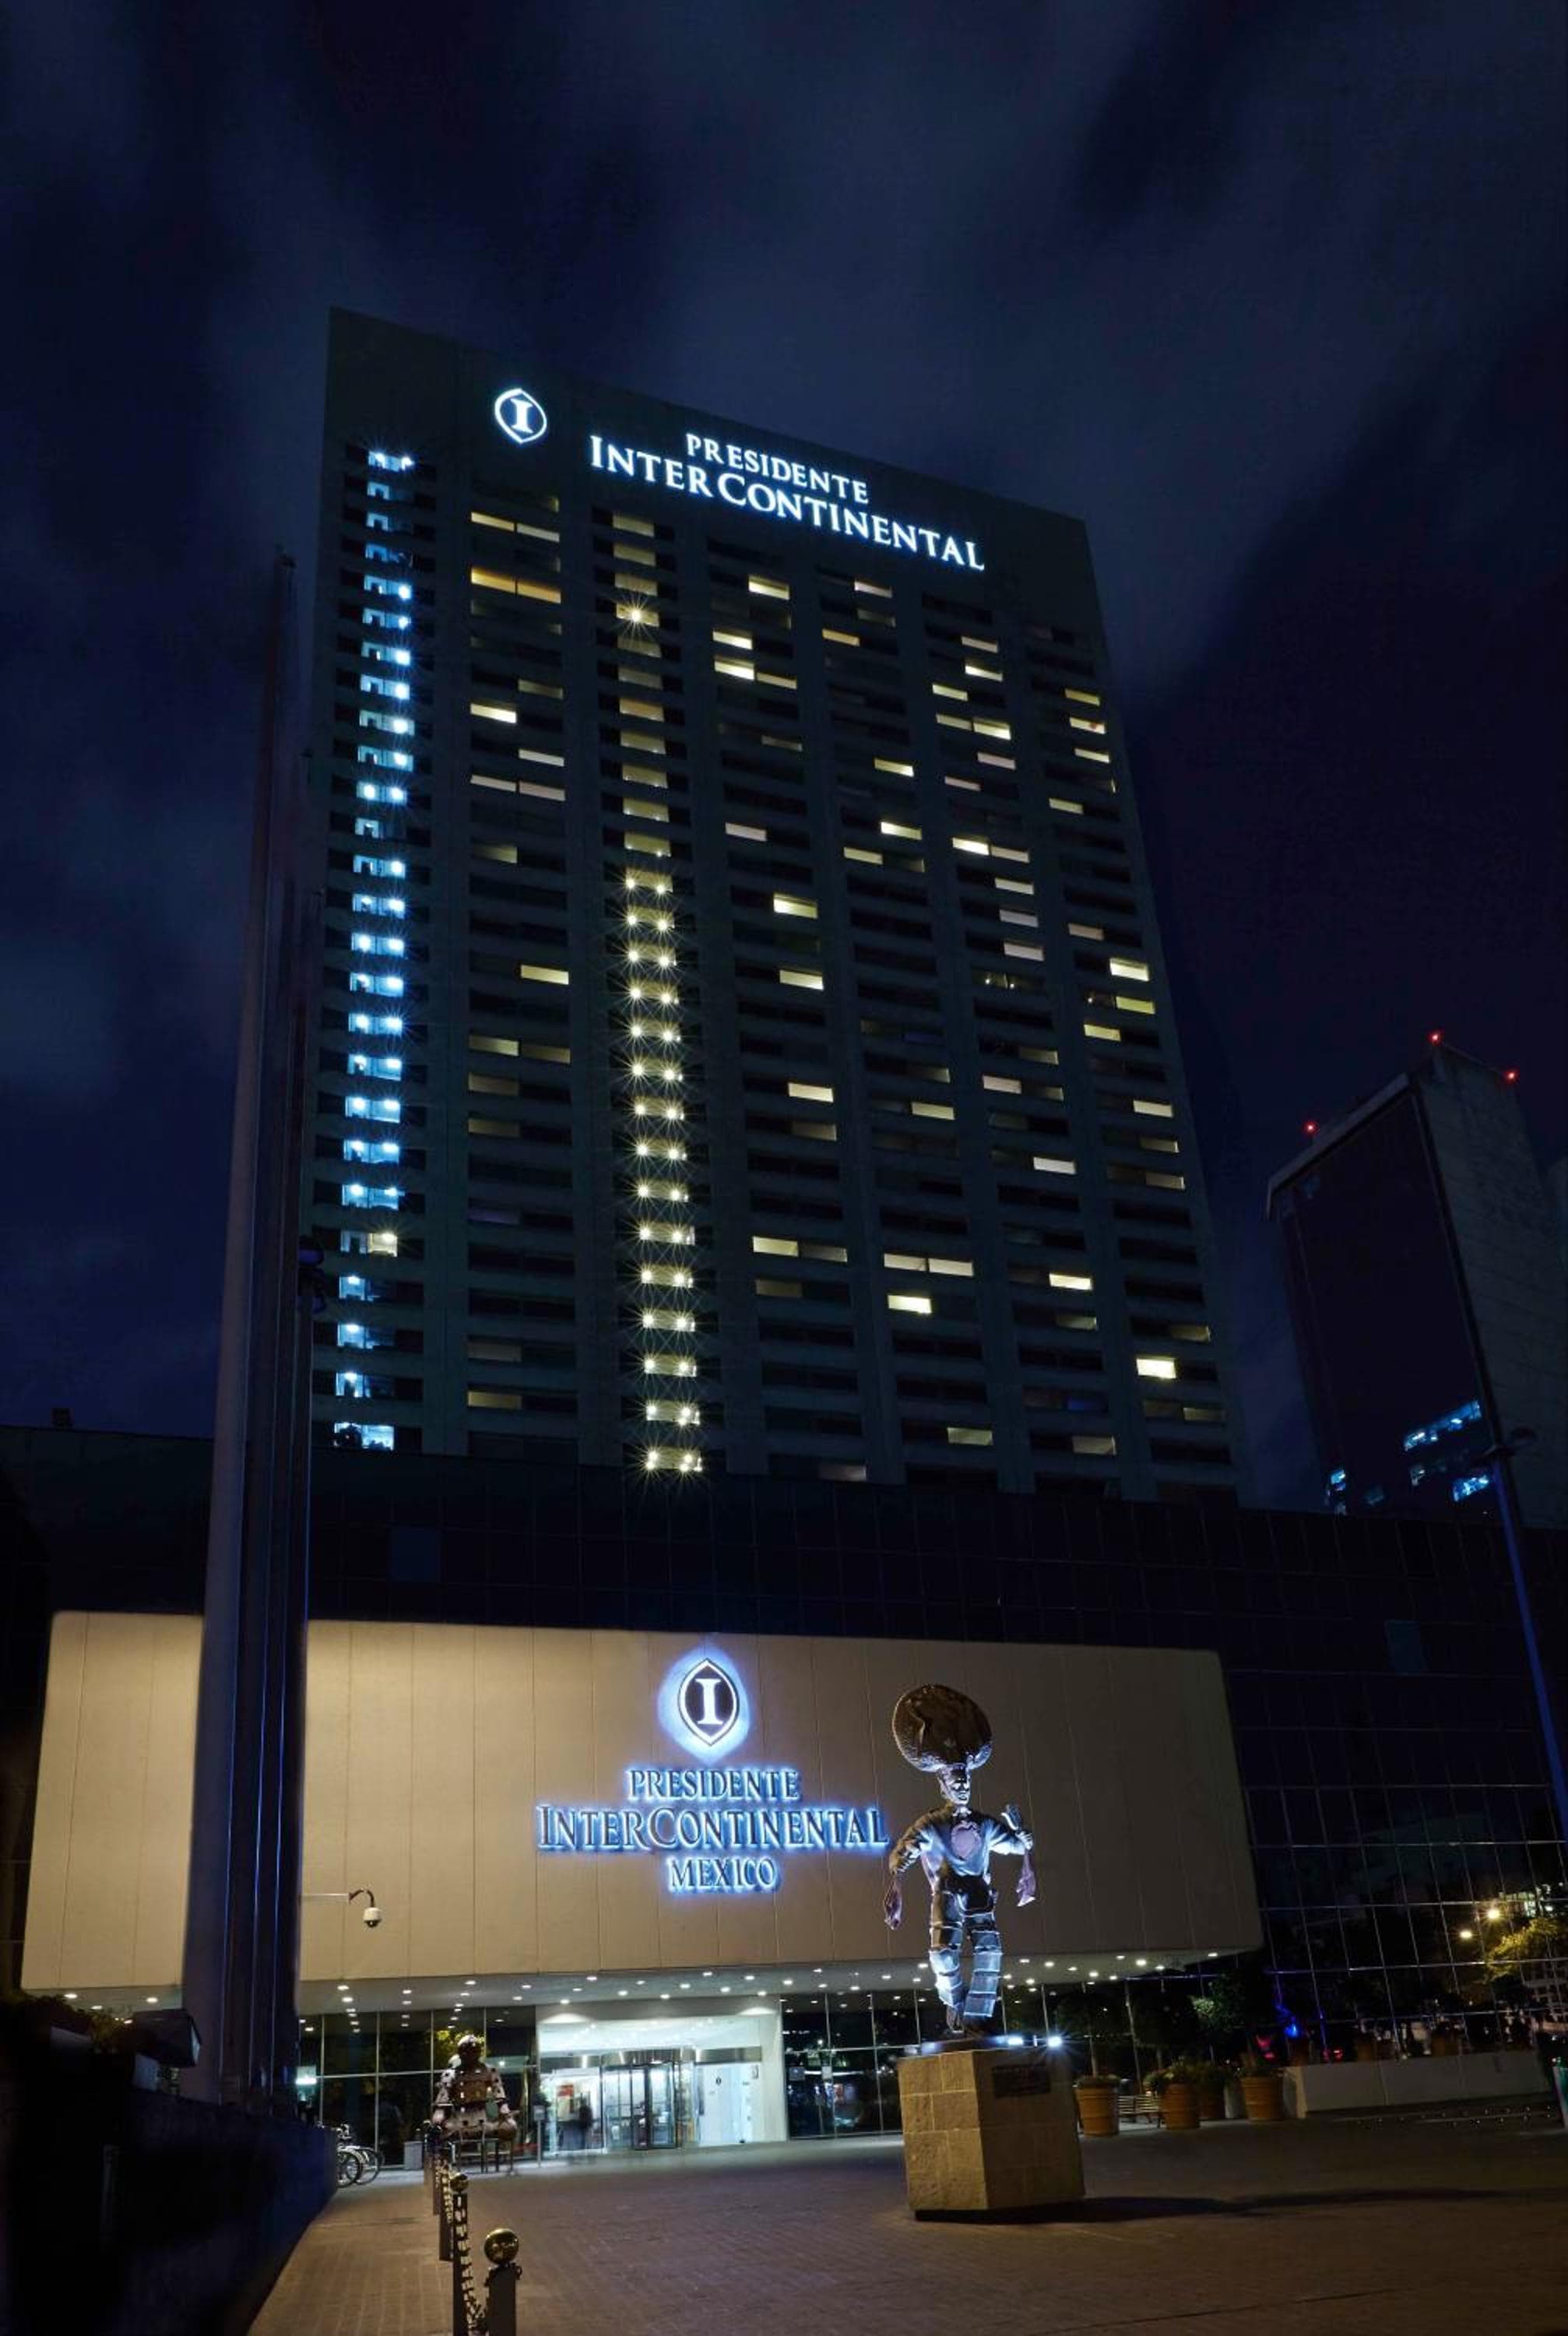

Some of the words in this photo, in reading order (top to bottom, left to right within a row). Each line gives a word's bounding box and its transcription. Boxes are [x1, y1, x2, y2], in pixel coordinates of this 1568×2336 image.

[685, 433, 870, 505] PRESIDENTE
[628, 1768, 800, 1803] PRESIDENTE
[537, 1803, 890, 1850] INTERCONTINENTAL
[668, 1856, 779, 1890] MEXICO
